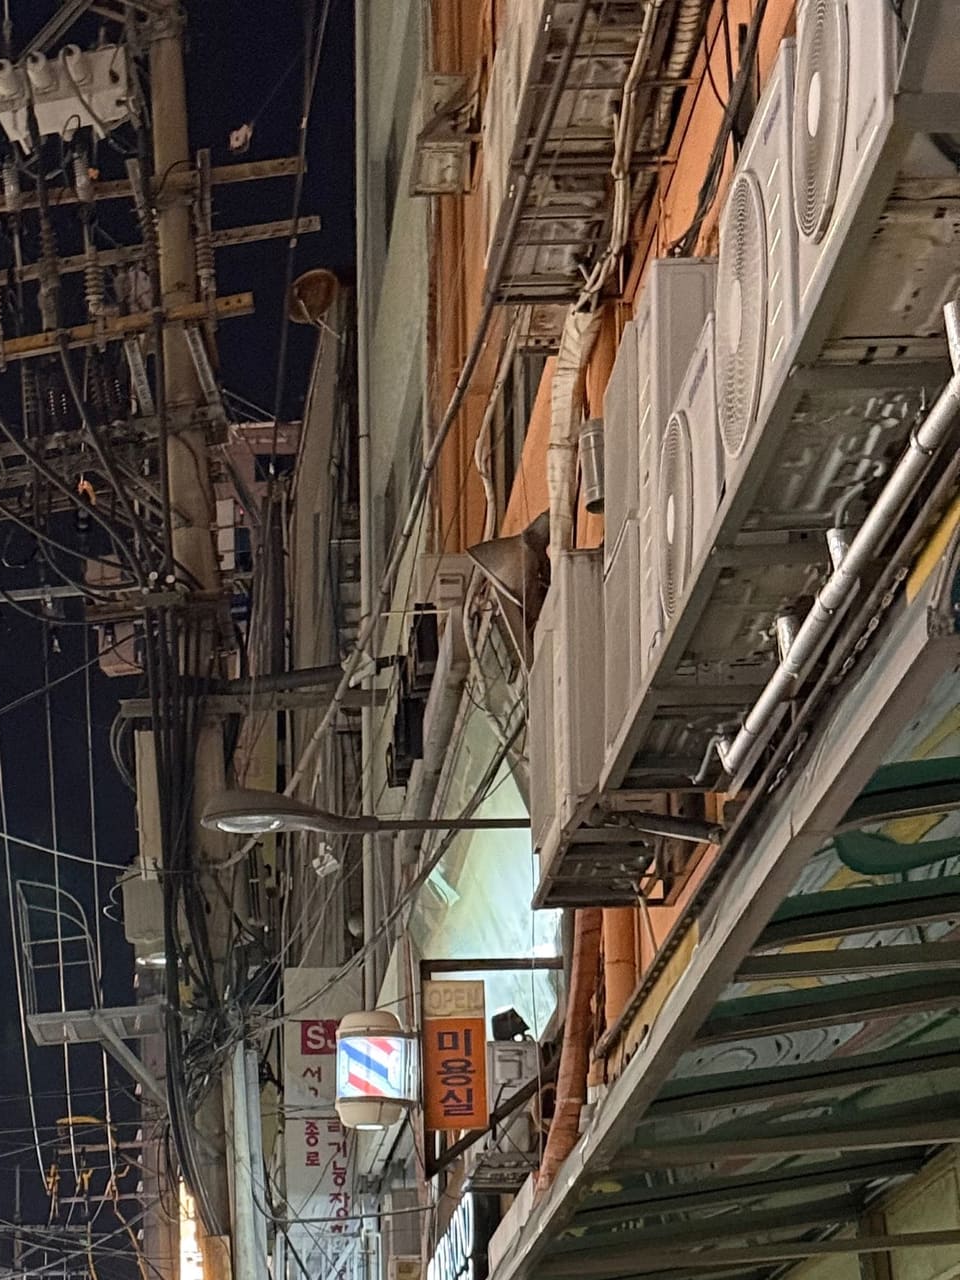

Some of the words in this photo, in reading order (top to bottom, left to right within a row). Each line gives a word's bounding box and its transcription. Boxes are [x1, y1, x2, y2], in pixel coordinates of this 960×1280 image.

[428, 986, 483, 1010] OPEN
[436, 1029, 475, 1117] 미용실
[304, 1120, 321, 1168] 종로
